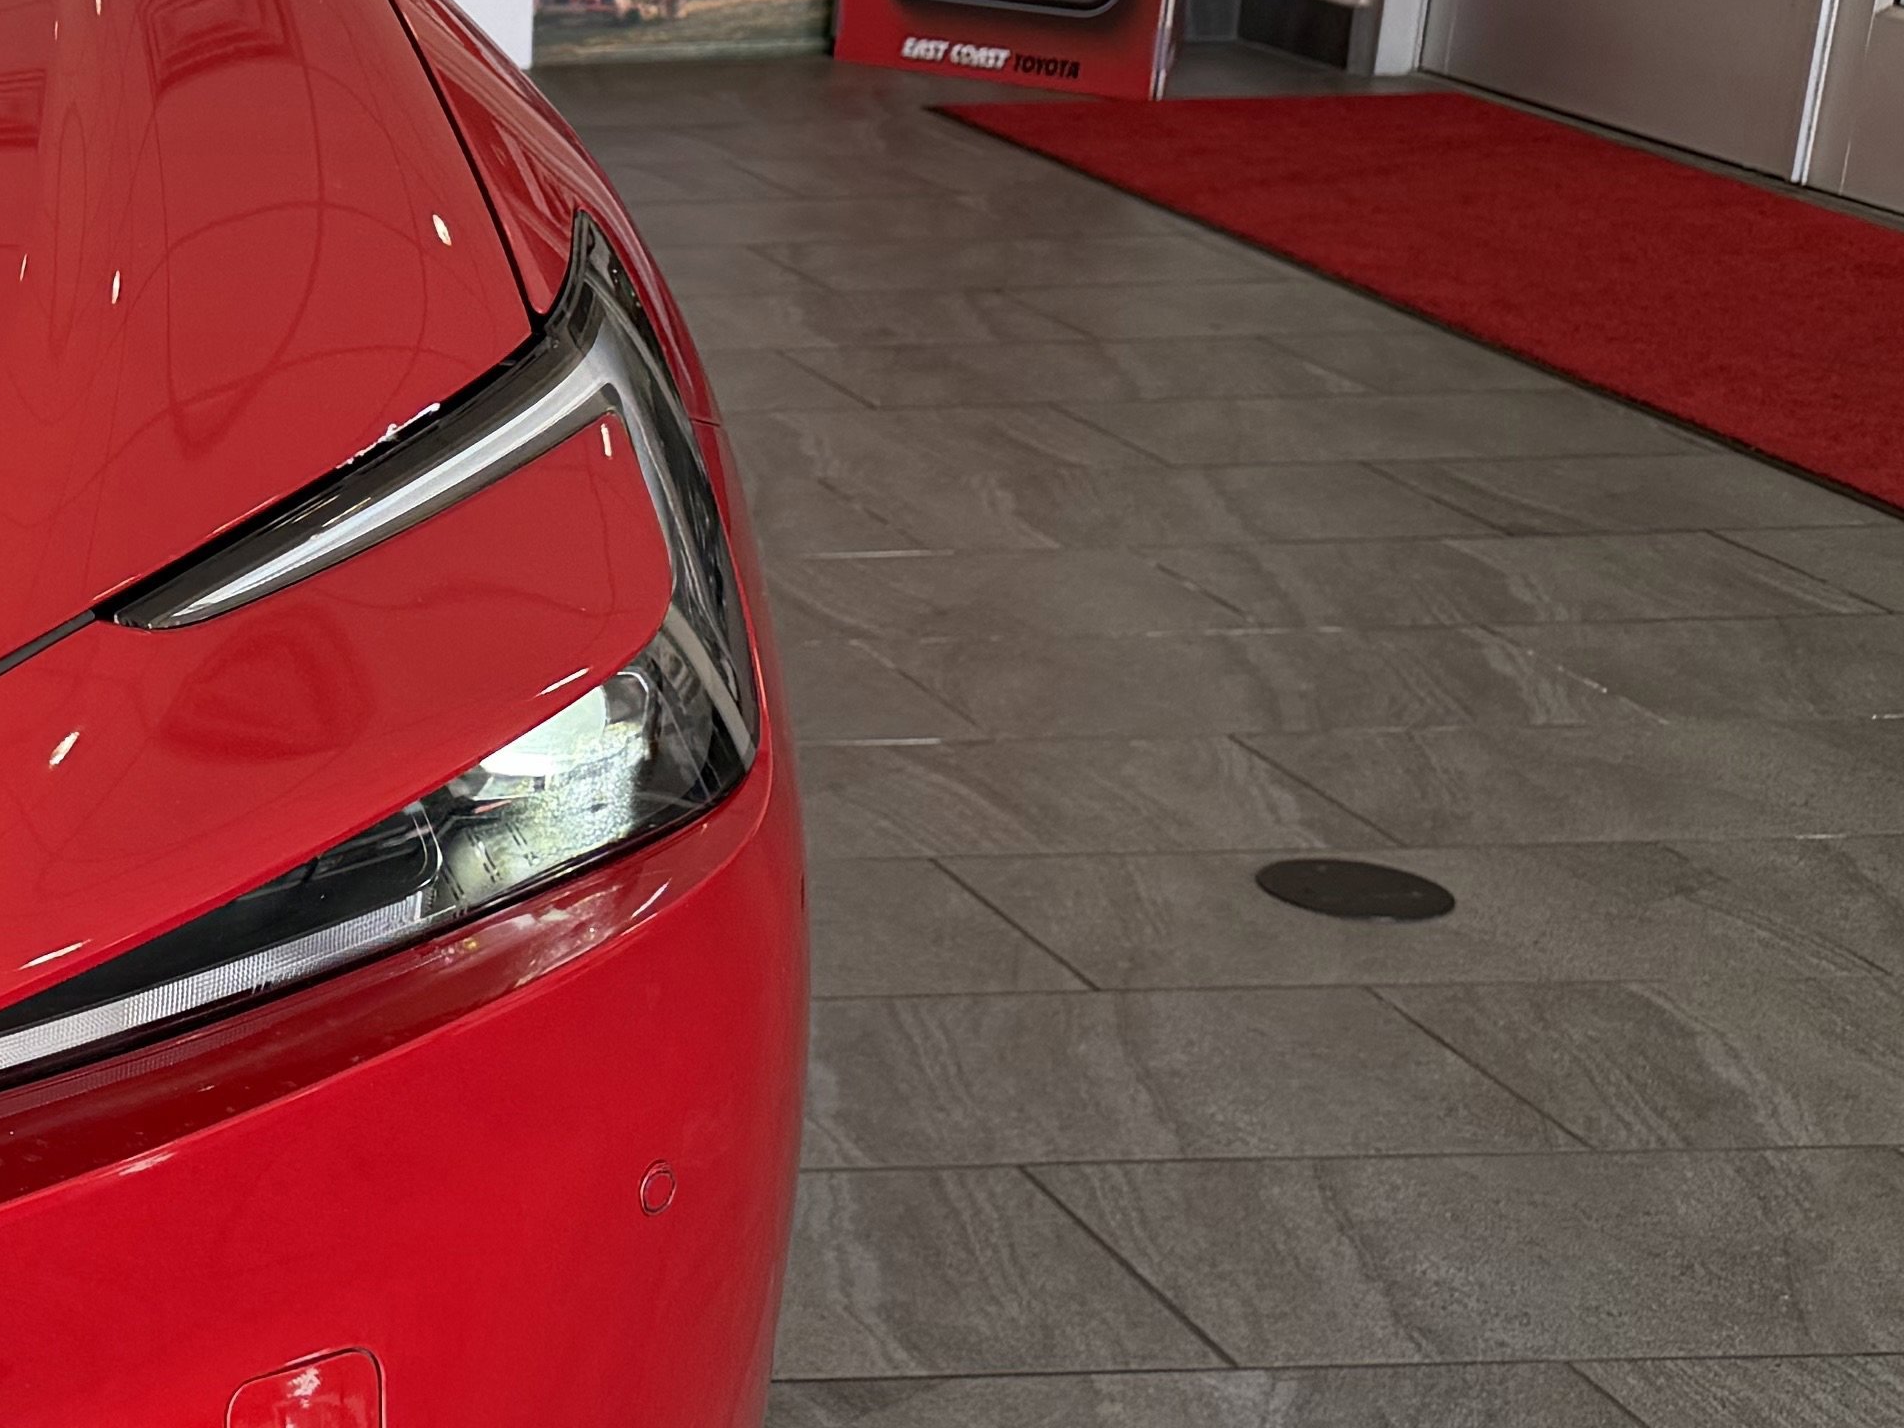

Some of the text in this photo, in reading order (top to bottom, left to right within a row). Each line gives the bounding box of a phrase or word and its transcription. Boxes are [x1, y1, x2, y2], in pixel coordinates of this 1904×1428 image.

[901, 37, 1080, 79] EAST COAST TOYOTA
